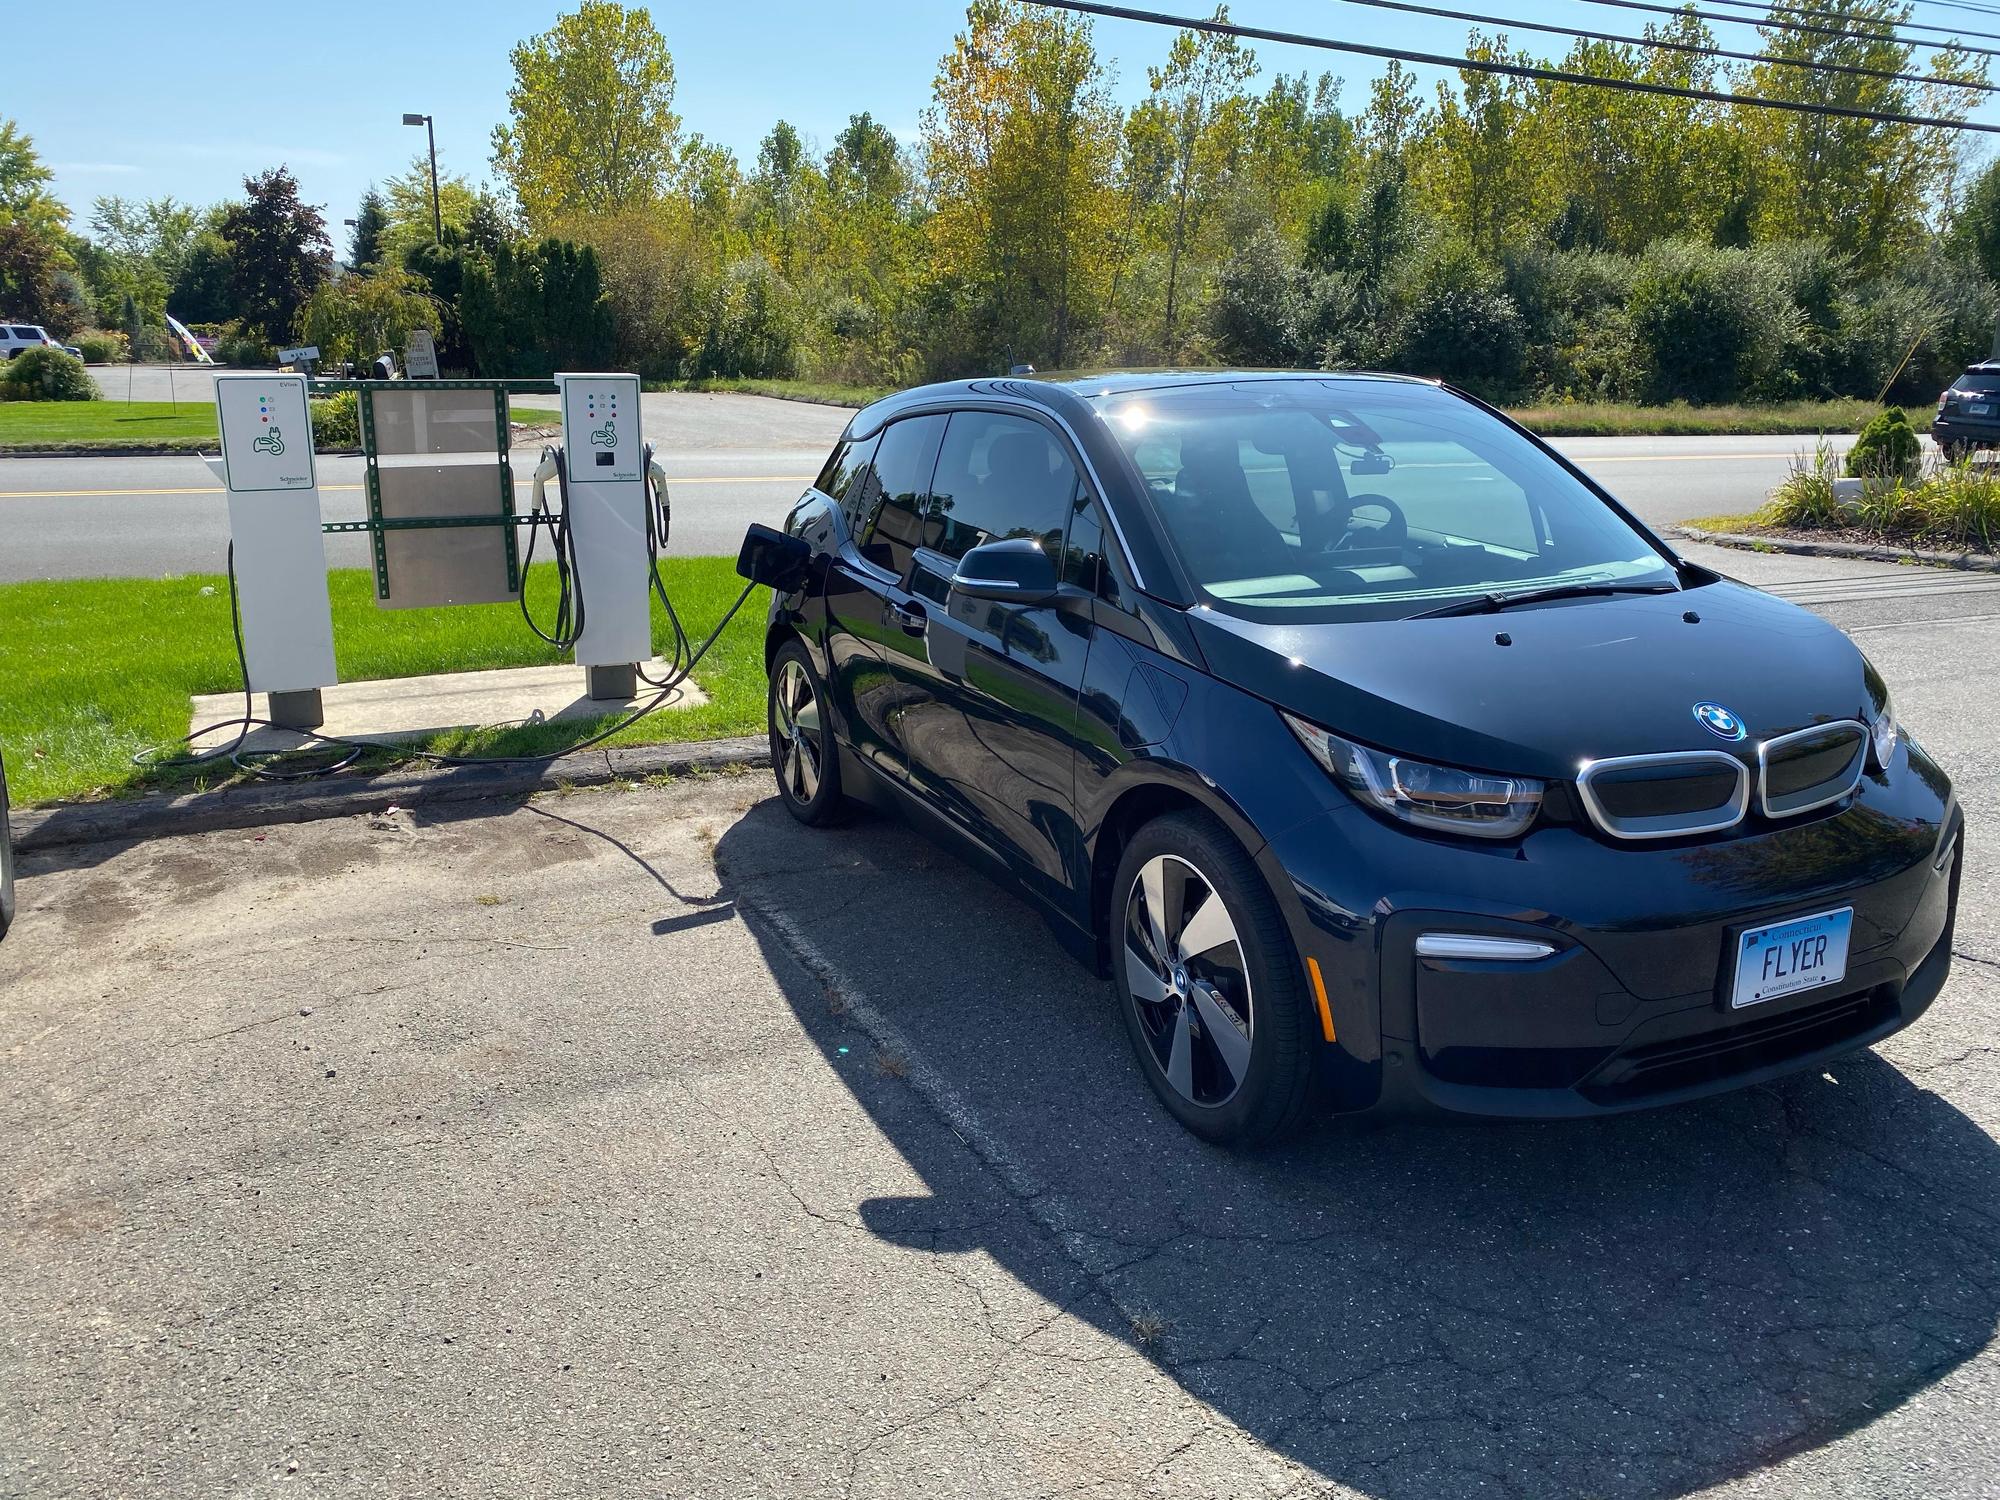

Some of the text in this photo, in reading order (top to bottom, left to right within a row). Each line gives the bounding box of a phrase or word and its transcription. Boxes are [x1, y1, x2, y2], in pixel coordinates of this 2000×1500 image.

[1762, 934, 1827, 981] FLYER
[1762, 975, 1819, 994] Constitution State
